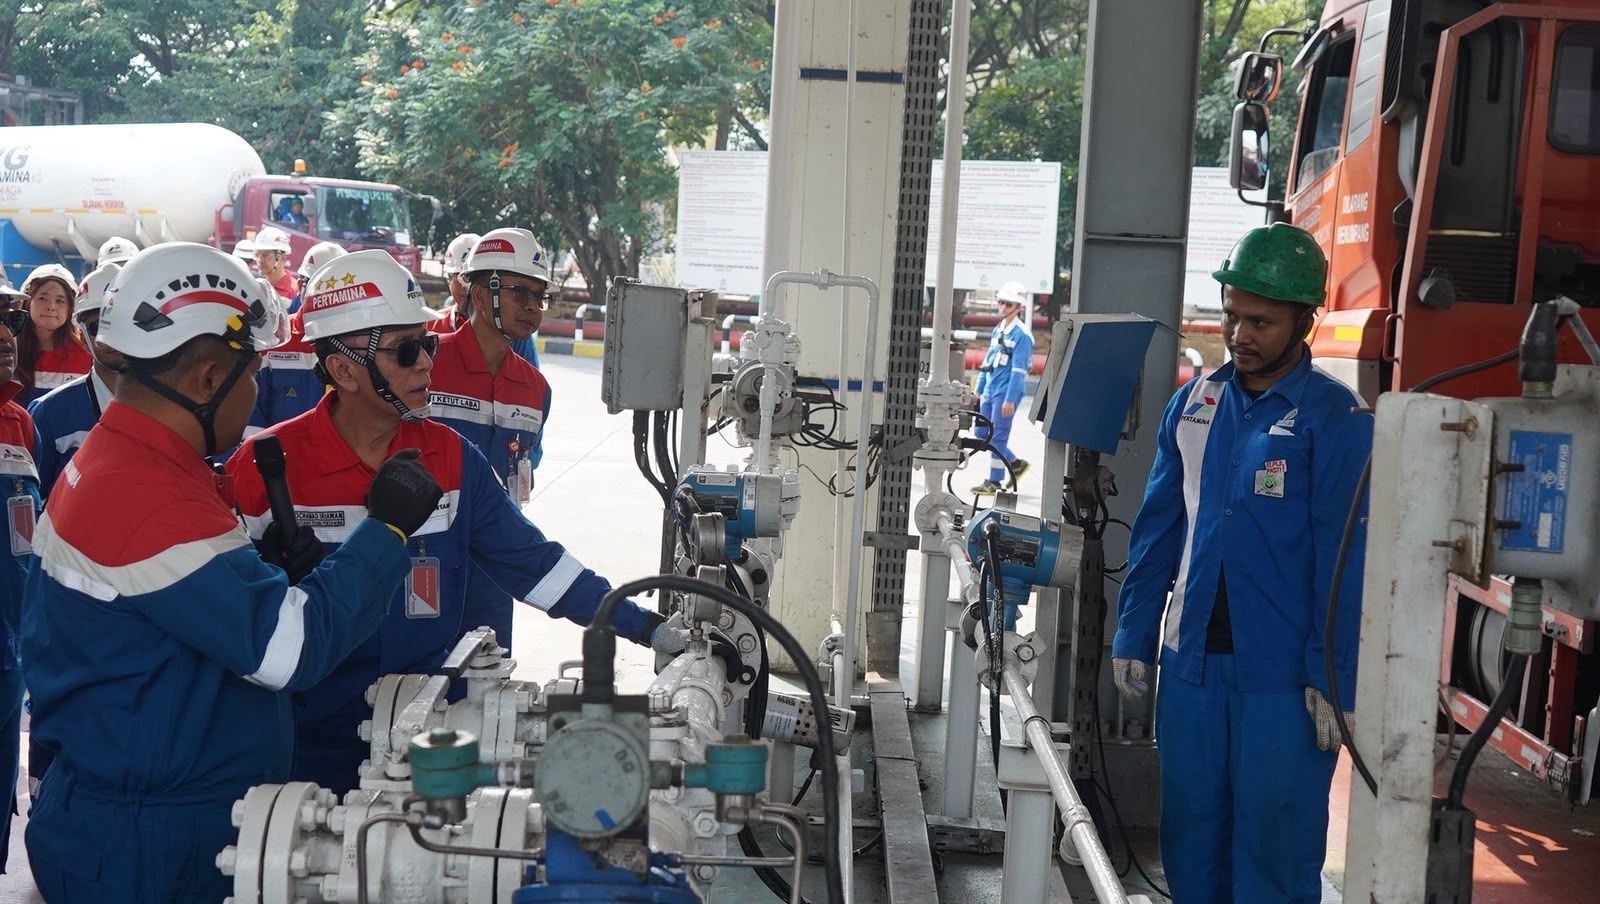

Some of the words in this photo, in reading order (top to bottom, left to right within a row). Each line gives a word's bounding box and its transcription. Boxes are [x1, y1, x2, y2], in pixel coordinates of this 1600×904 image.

[0, 145, 29, 170] G
[0, 170, 30, 182] MINA
[1342, 192, 1368, 214] DILARANG
[312, 285, 367, 310] PERTAMINA
[437, 396, 460, 406] KETUT
[460, 399, 478, 409] LABA
[1181, 415, 1210, 425] PERTAMINA
